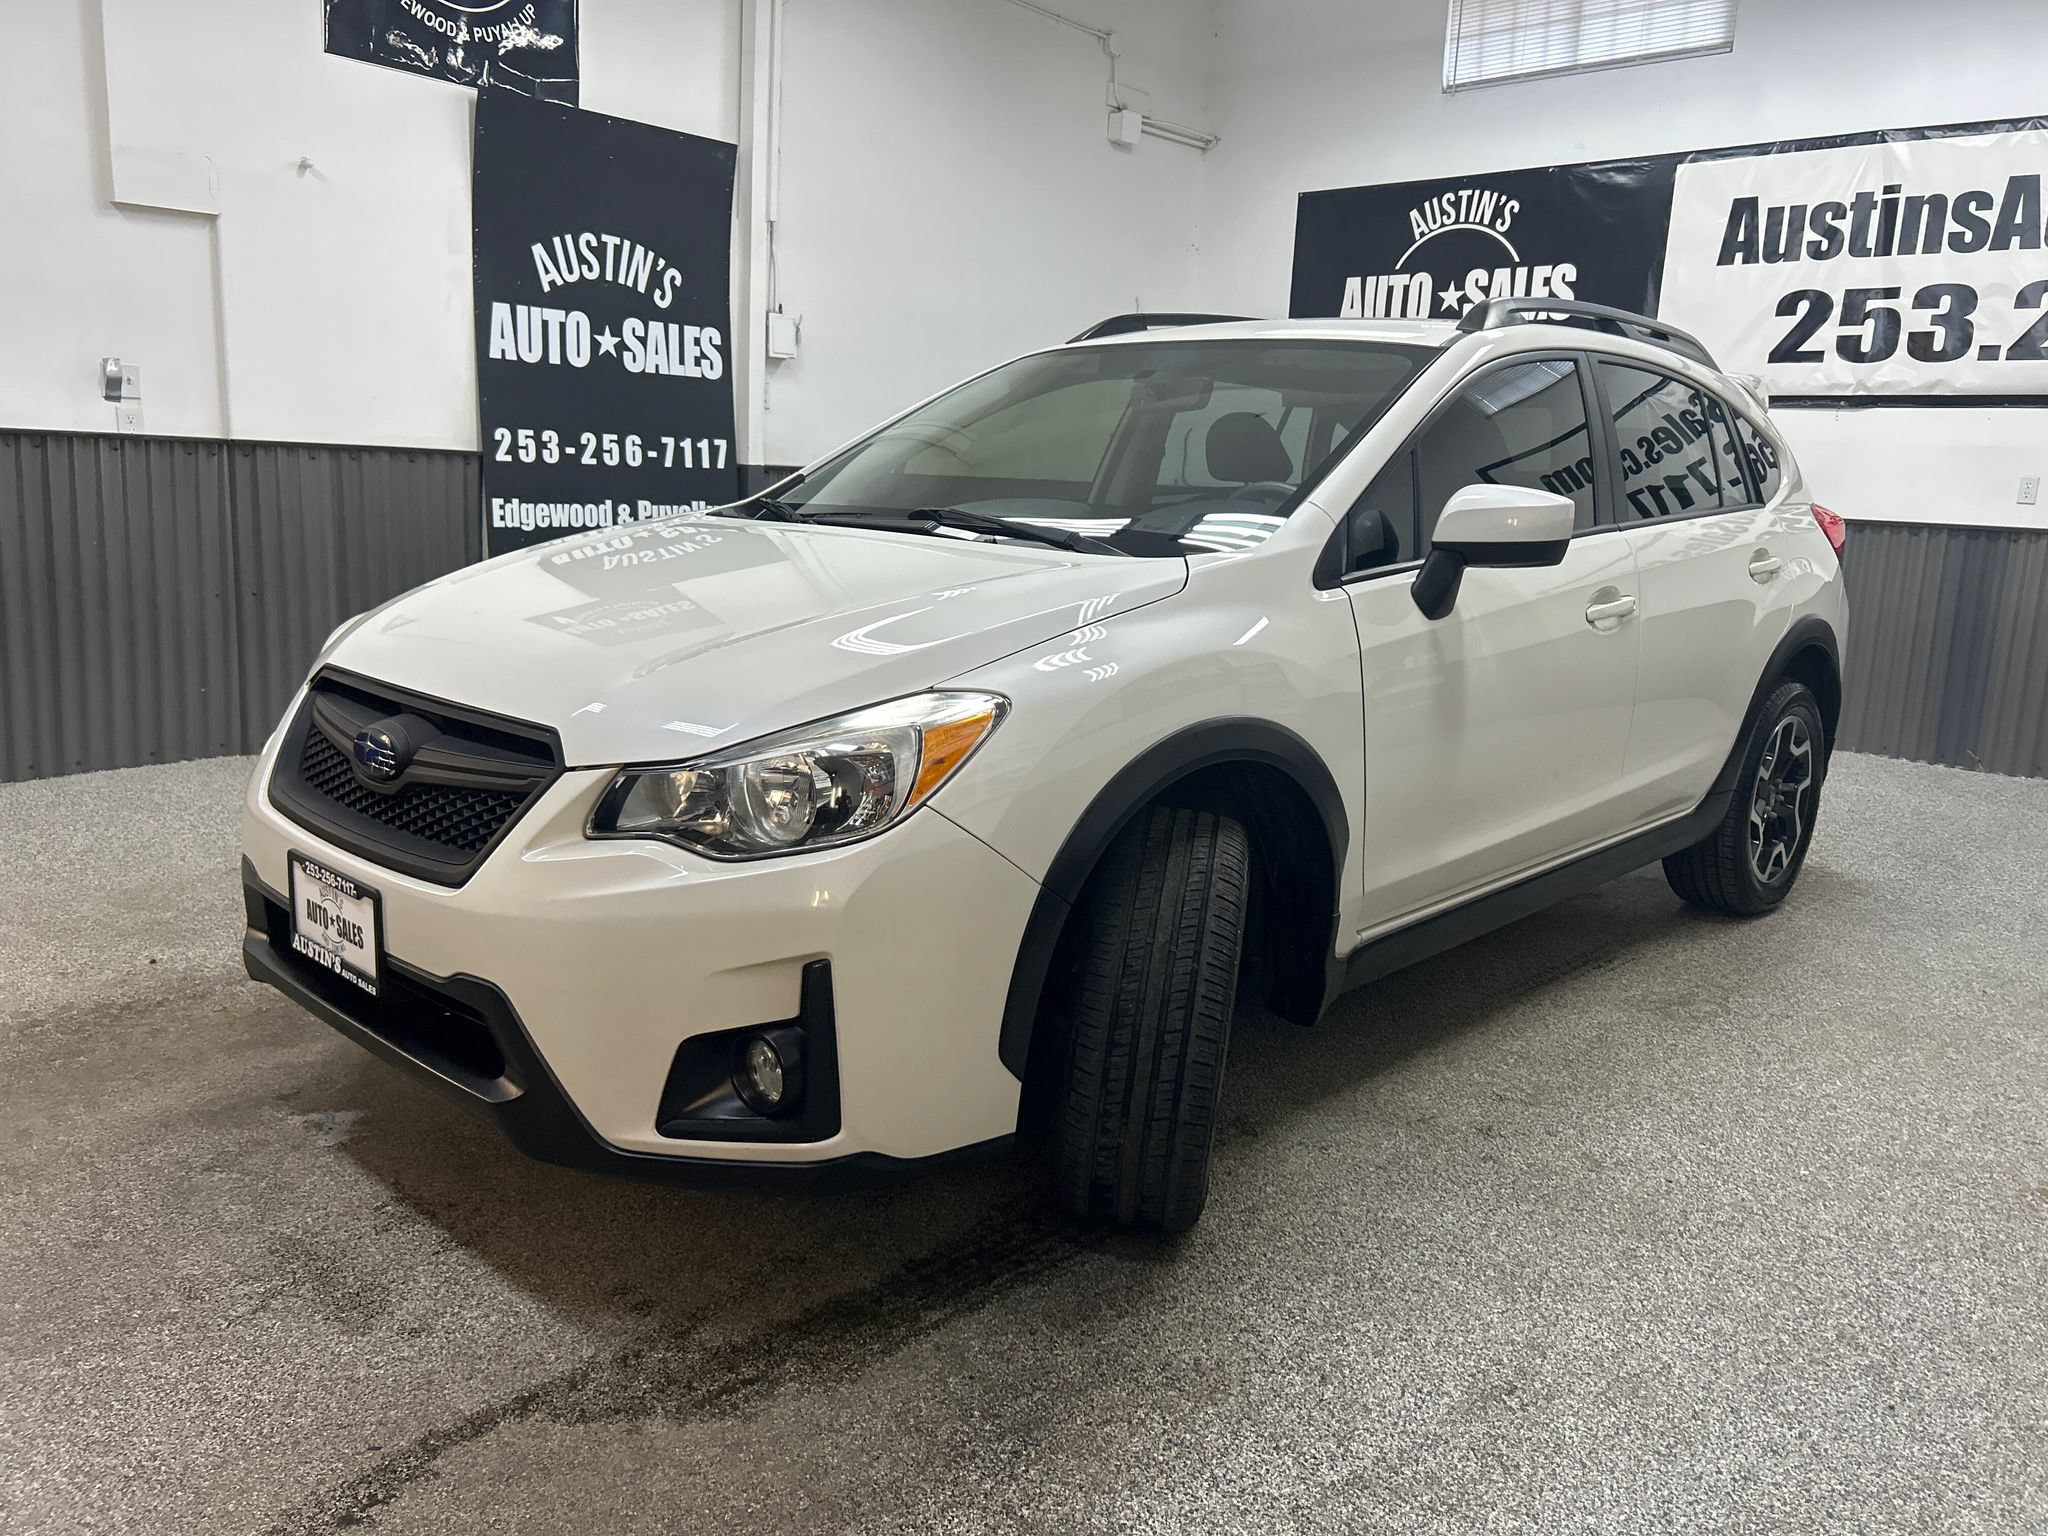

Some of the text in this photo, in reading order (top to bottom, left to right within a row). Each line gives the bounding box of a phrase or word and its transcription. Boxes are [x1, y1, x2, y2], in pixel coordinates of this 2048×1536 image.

[1409, 189, 1520, 241] AUSTIN'S
[531, 232, 683, 309] AUSTIN'S
[1340, 263, 1577, 321] AUTO SALES
[489, 301, 723, 381] AUTO SALES
[494, 427, 728, 469] 253-256-7117
[492, 498, 613, 531] Edgewood
[617, 503, 635, 526] &
[306, 898, 329, 931] AUTO
[336, 914, 364, 950] SALES
[292, 933, 342, 974] AUSTIN'S
[341, 968, 358, 984] AUTO
[358, 978, 377, 996] SALES
